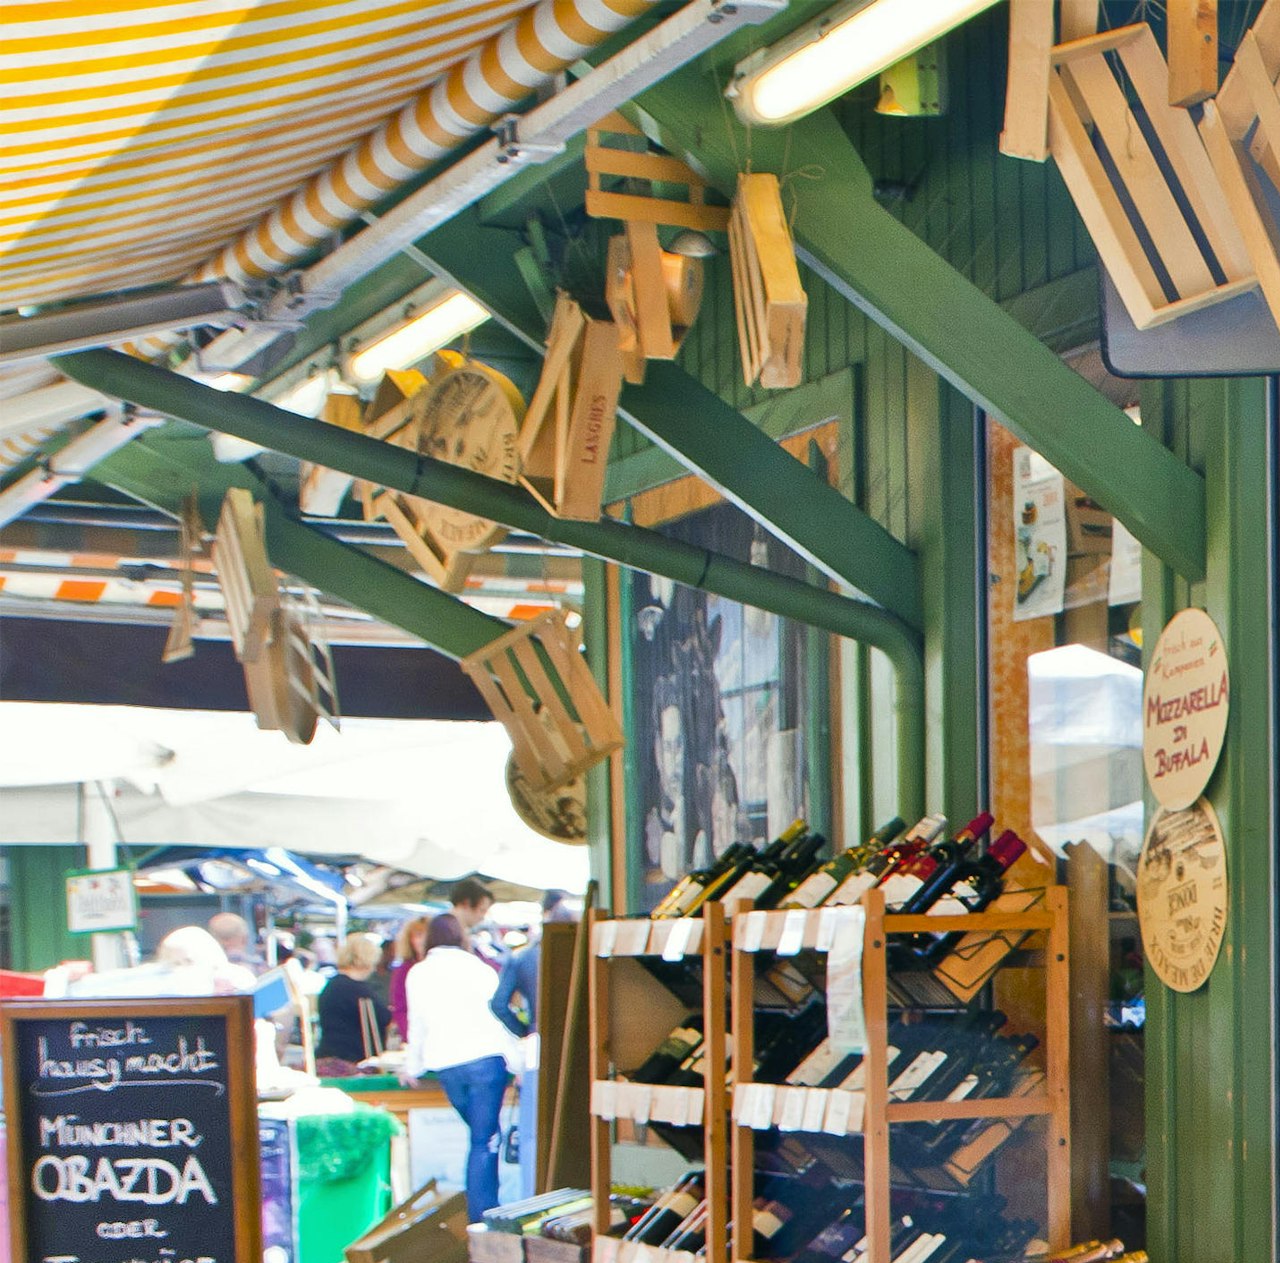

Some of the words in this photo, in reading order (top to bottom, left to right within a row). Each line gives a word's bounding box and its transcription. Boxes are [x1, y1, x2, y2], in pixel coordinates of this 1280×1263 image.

[1146, 670, 1229, 729] MOZZARELLA
[1154, 736, 1210, 779] BUFFALA
[40, 1113, 200, 1149] MÜNCHNER
[31, 1153, 218, 1205] OBAZDA
